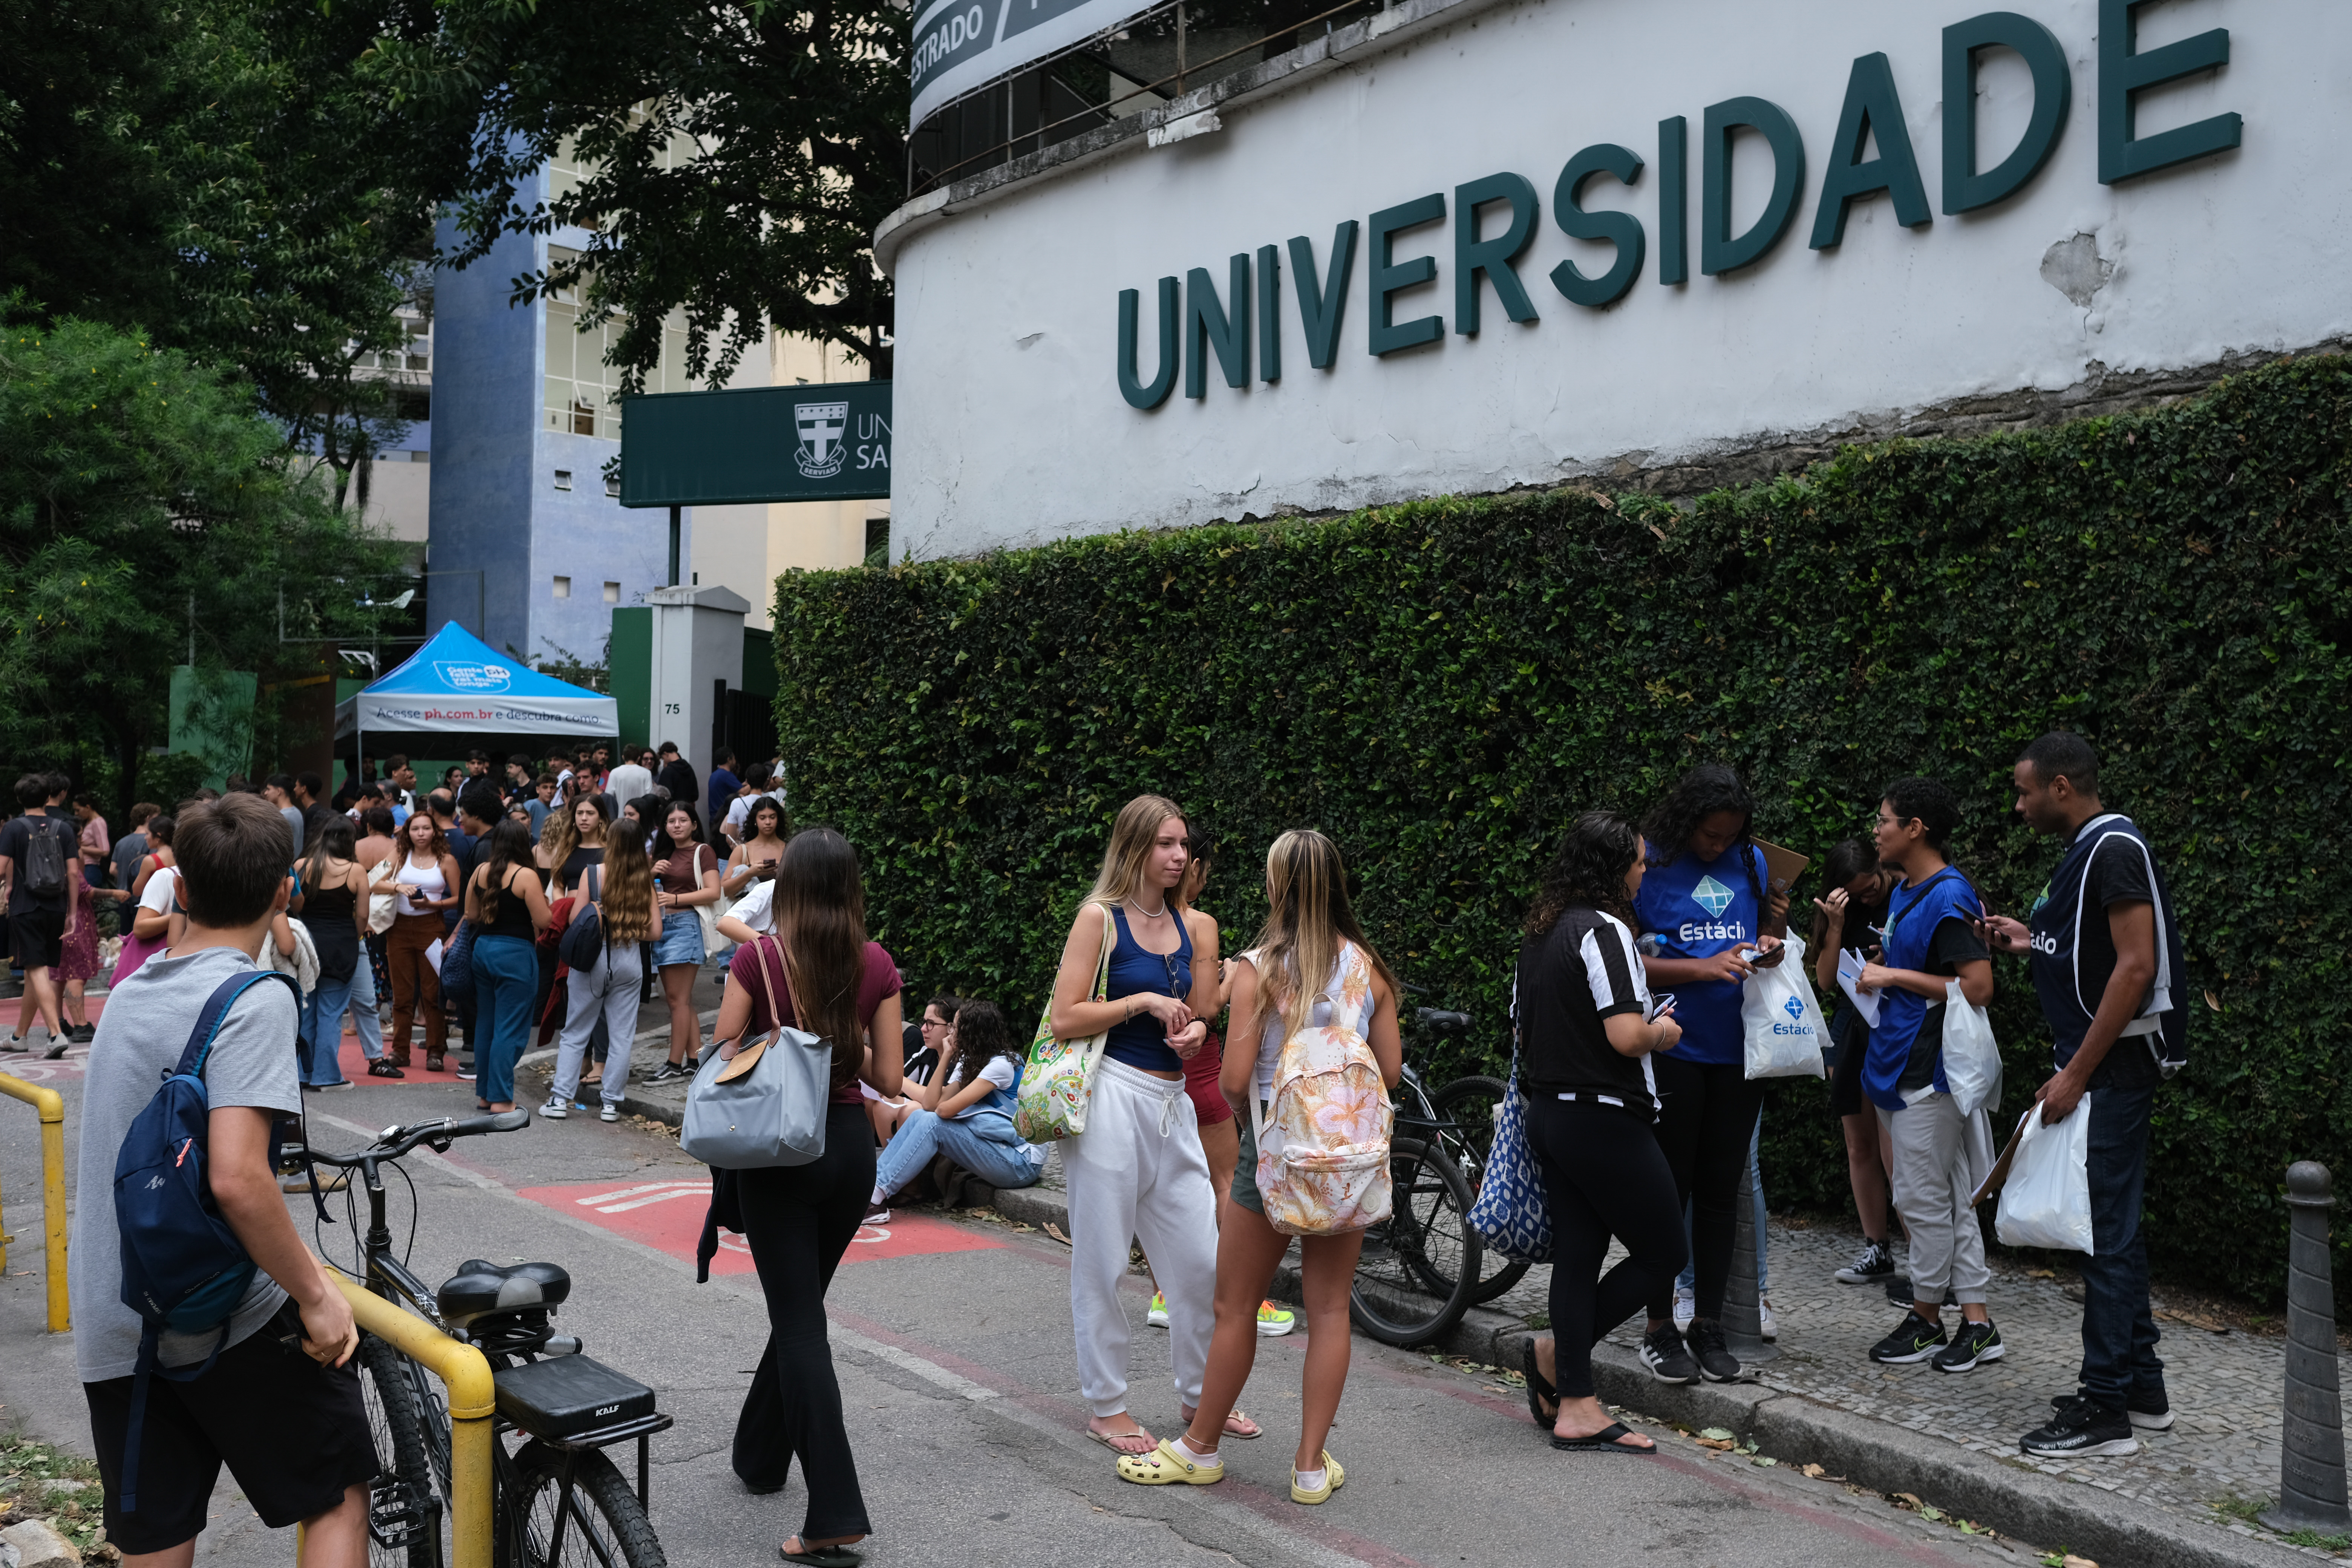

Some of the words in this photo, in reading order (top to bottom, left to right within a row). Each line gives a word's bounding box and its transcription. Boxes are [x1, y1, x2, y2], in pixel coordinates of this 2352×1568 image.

[1117, 0, 2243, 411] UNIVERSIDADE
[804, 467, 837, 475] SERVIAM
[377, 707, 420, 718] Acesse
[424, 708, 493, 720] ph.com.br
[496, 711, 503, 719] e
[507, 709, 562, 721] descubra
[565, 714, 602, 724] como.
[665, 704, 680, 714] 75
[1773, 1023, 1814, 1035] Estácio
[596, 1404, 620, 1417] KALF
[2057, 1435, 2087, 1449] balance
